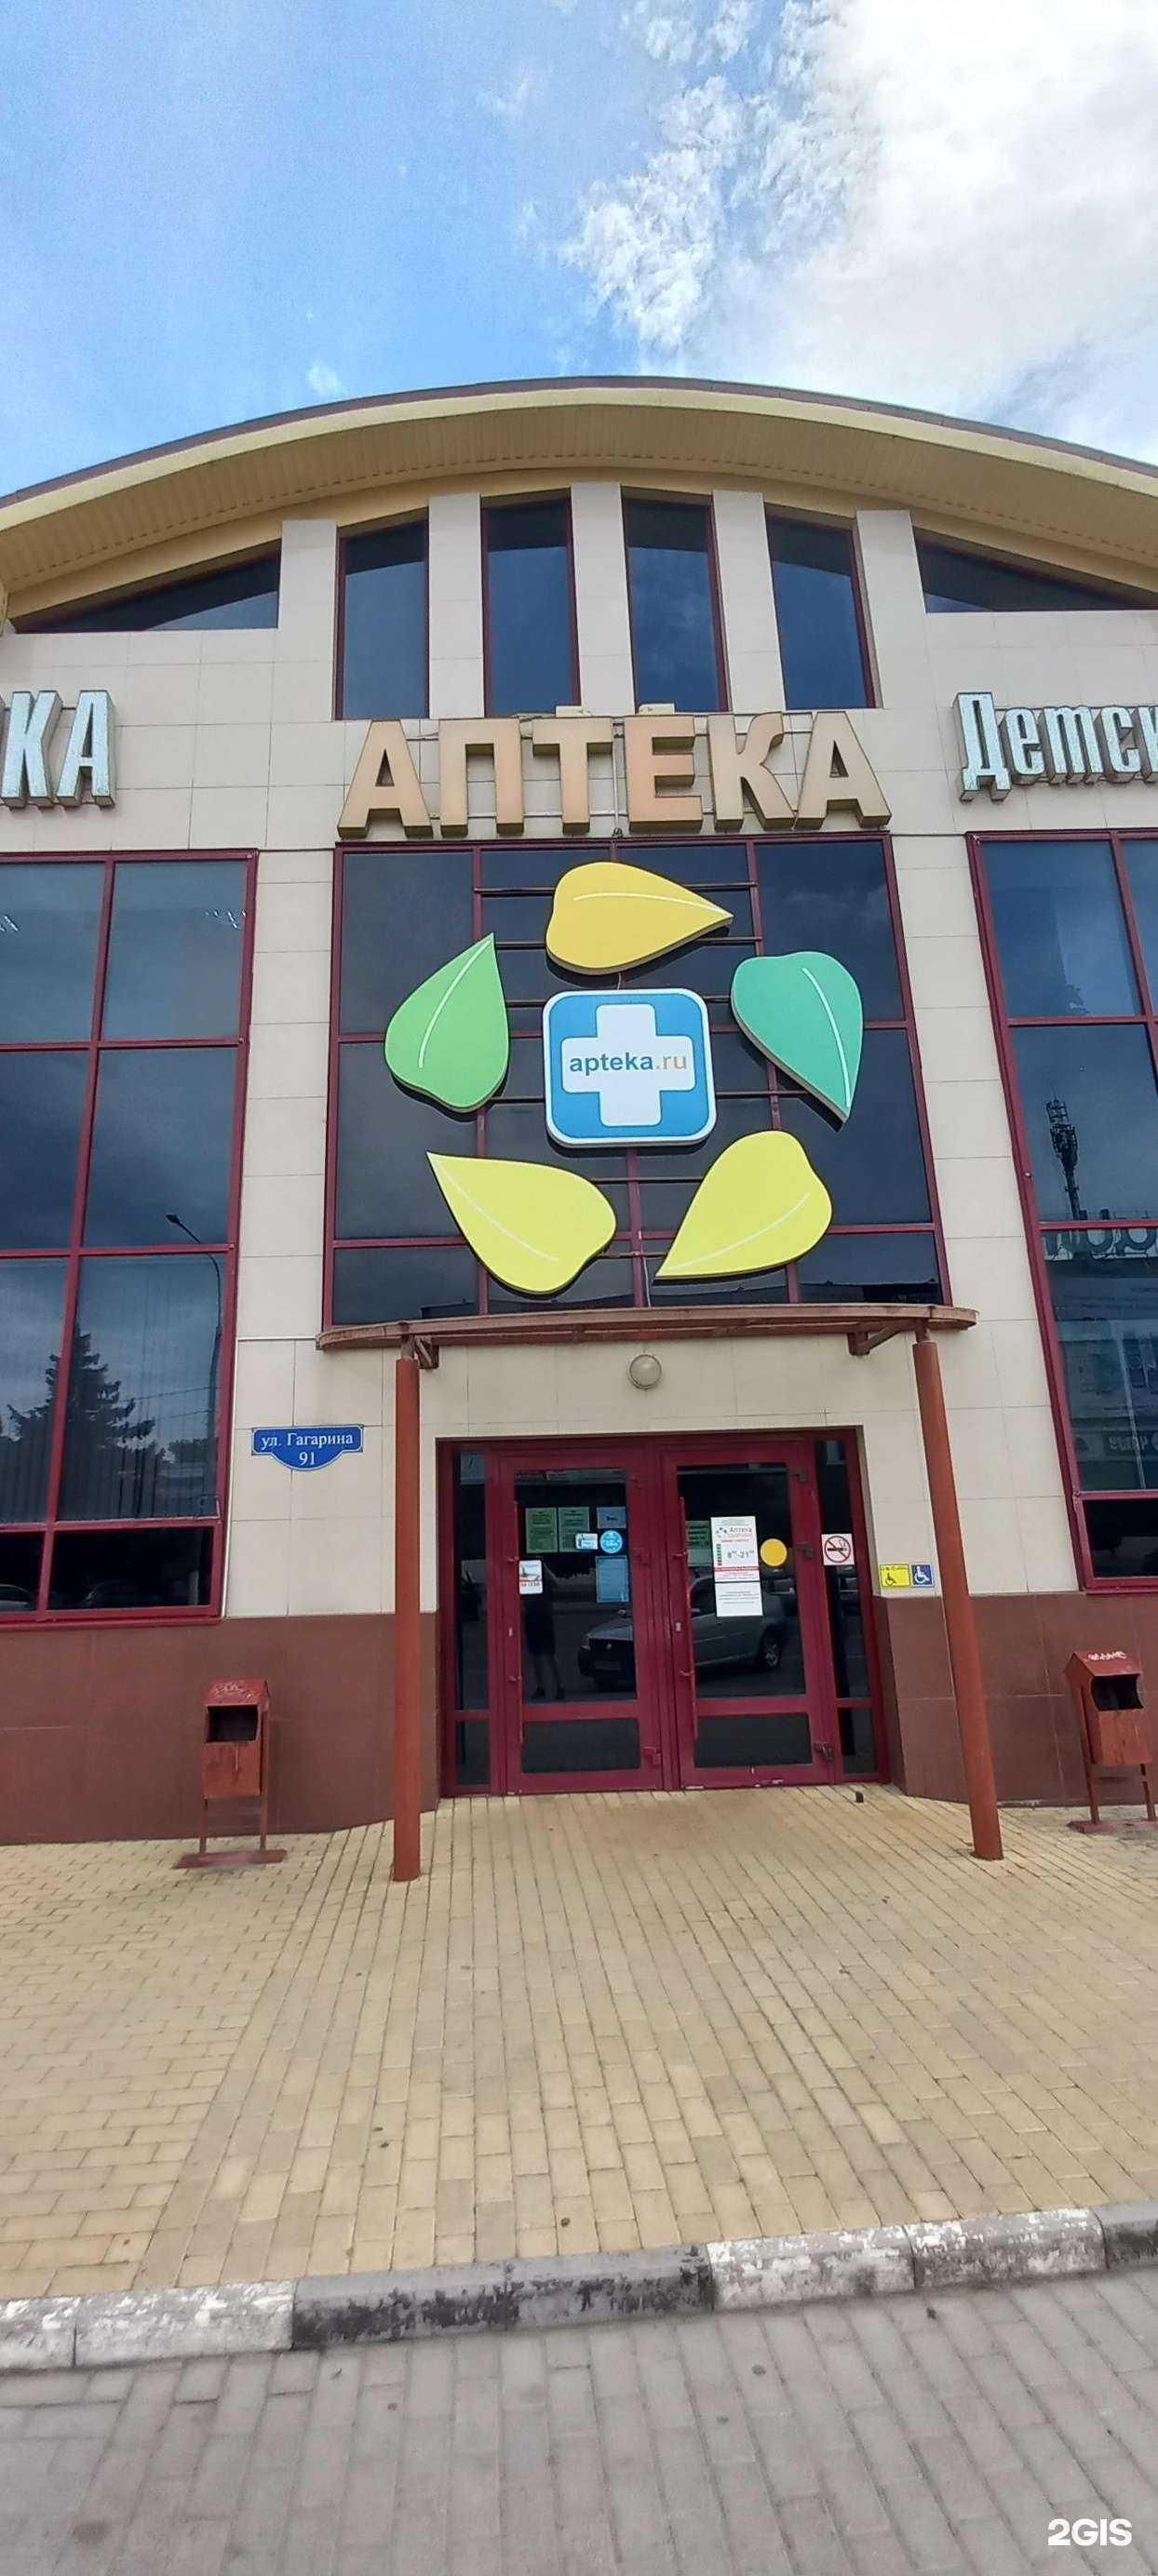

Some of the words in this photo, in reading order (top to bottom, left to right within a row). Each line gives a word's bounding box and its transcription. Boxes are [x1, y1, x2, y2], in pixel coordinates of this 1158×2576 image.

[0, 689, 115, 807] КА
[337, 710, 892, 838] АПТЕКА
[570, 1052, 687, 1076] apteka.ru
[262, 1436, 282, 1450] ул.
[287, 1432, 354, 1448] Гагарина
[299, 1451, 316, 1466] 91
